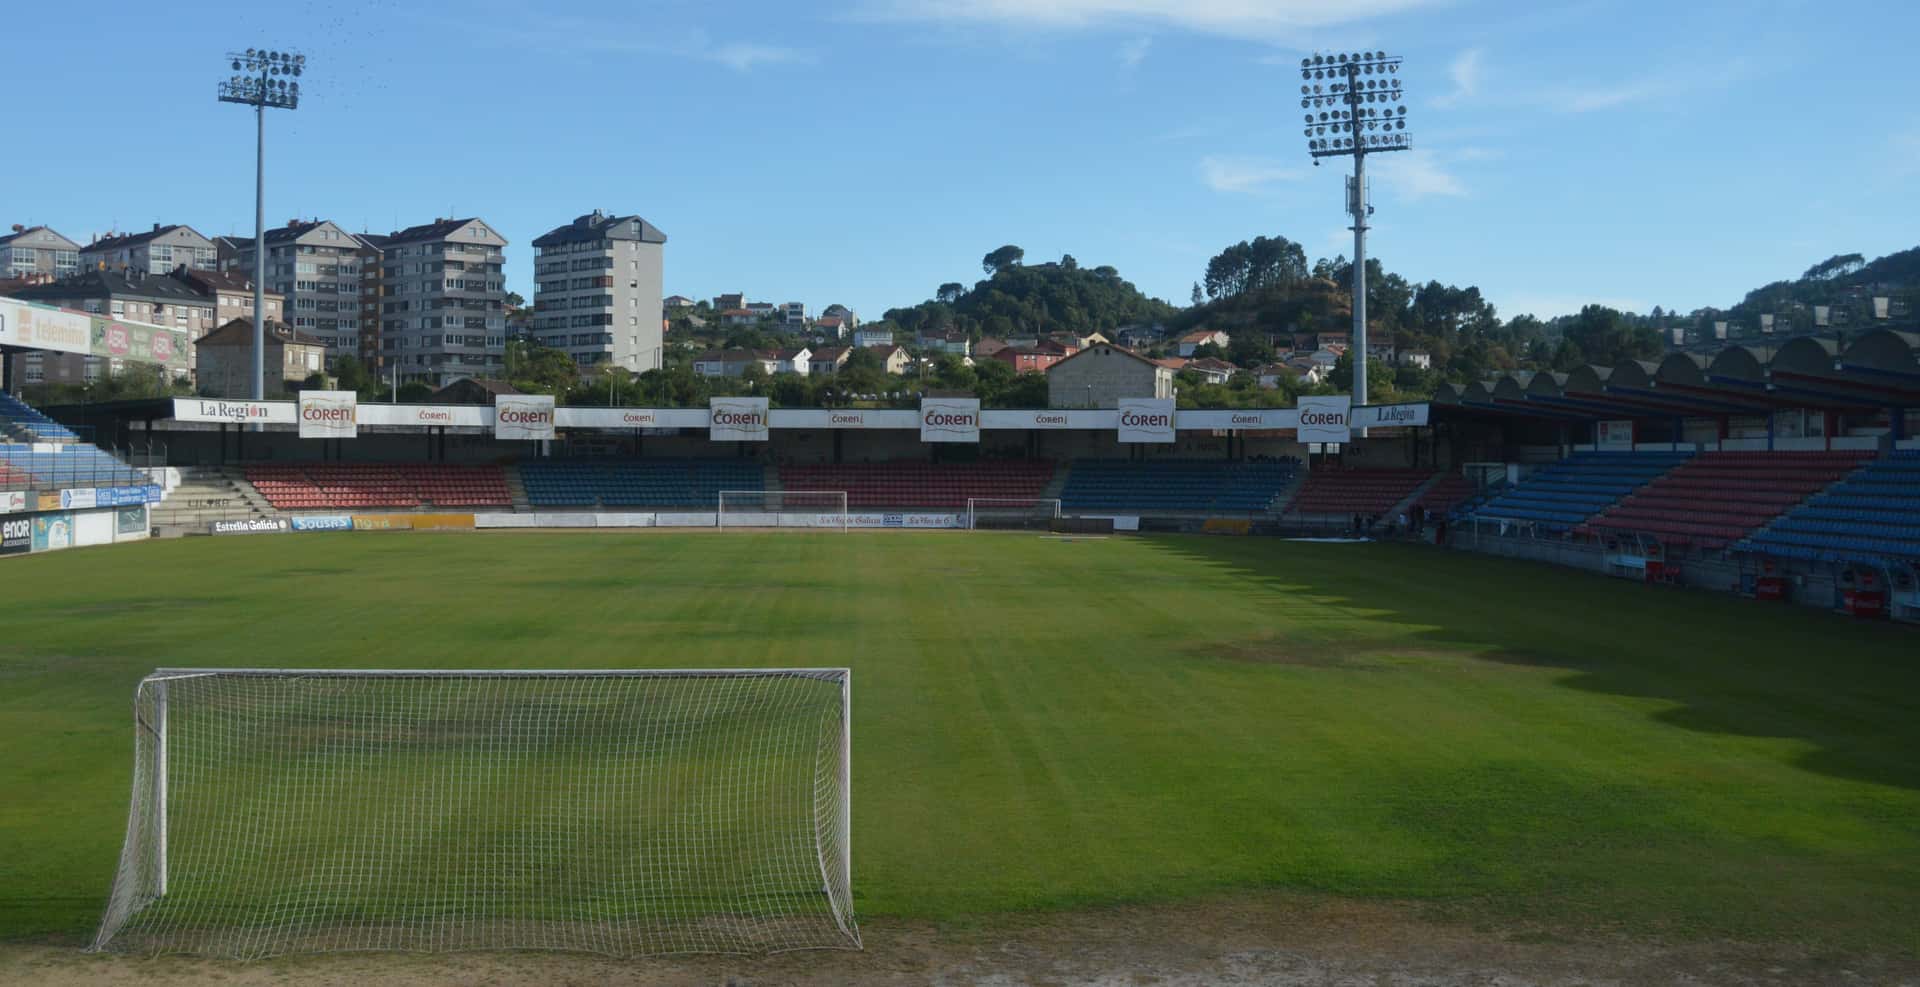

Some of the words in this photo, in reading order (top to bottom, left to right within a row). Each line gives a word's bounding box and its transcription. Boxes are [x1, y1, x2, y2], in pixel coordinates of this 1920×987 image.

[200, 401, 216, 416] La
[219, 402, 268, 420] Región
[216, 521, 248, 532] Estrella
[249, 520, 278, 530] Galicia
